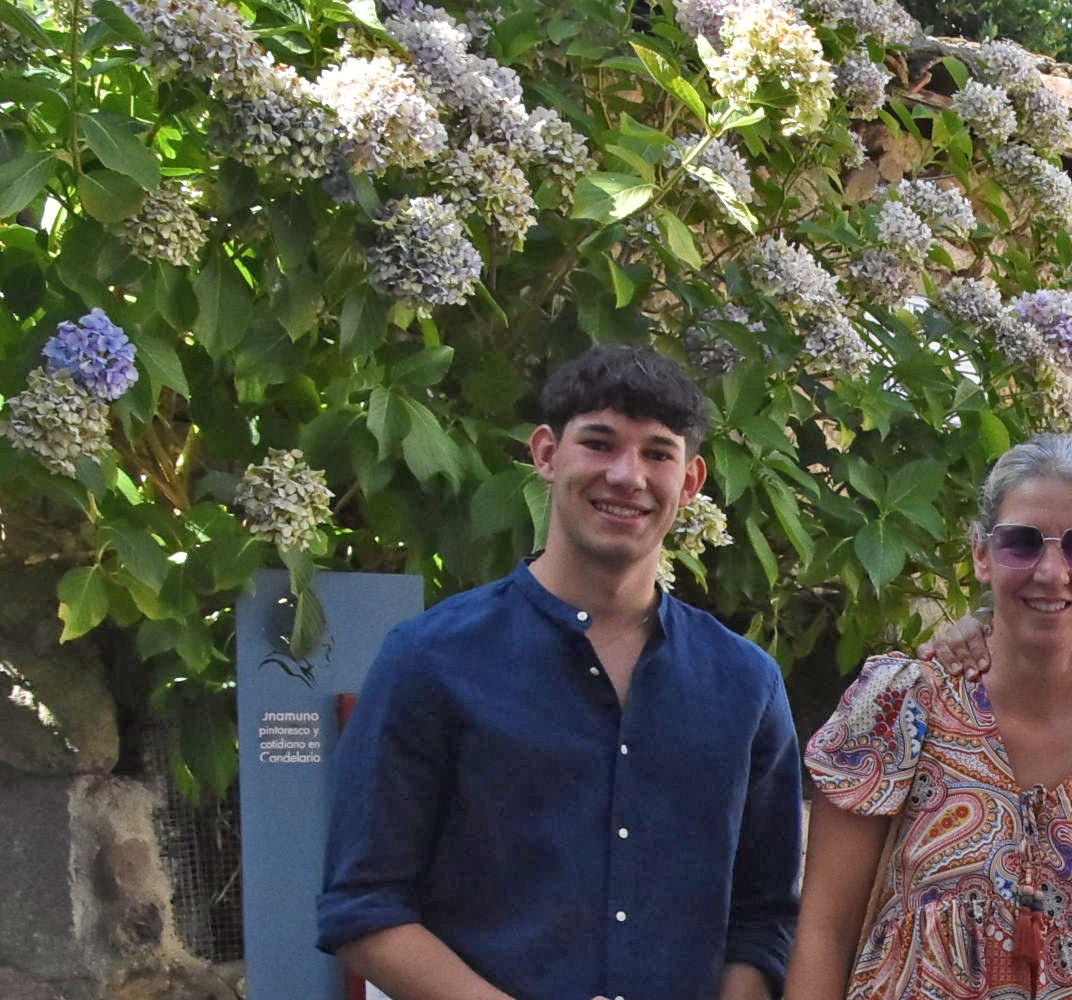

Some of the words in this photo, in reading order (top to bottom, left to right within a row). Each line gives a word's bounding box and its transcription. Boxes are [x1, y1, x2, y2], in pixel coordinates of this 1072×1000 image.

[259, 726, 310, 738] pintoresco
[313, 727, 320, 738] y
[260, 738, 306, 749] cotidiano
[308, 741, 320, 749] en
[259, 751, 321, 763] Candelario
